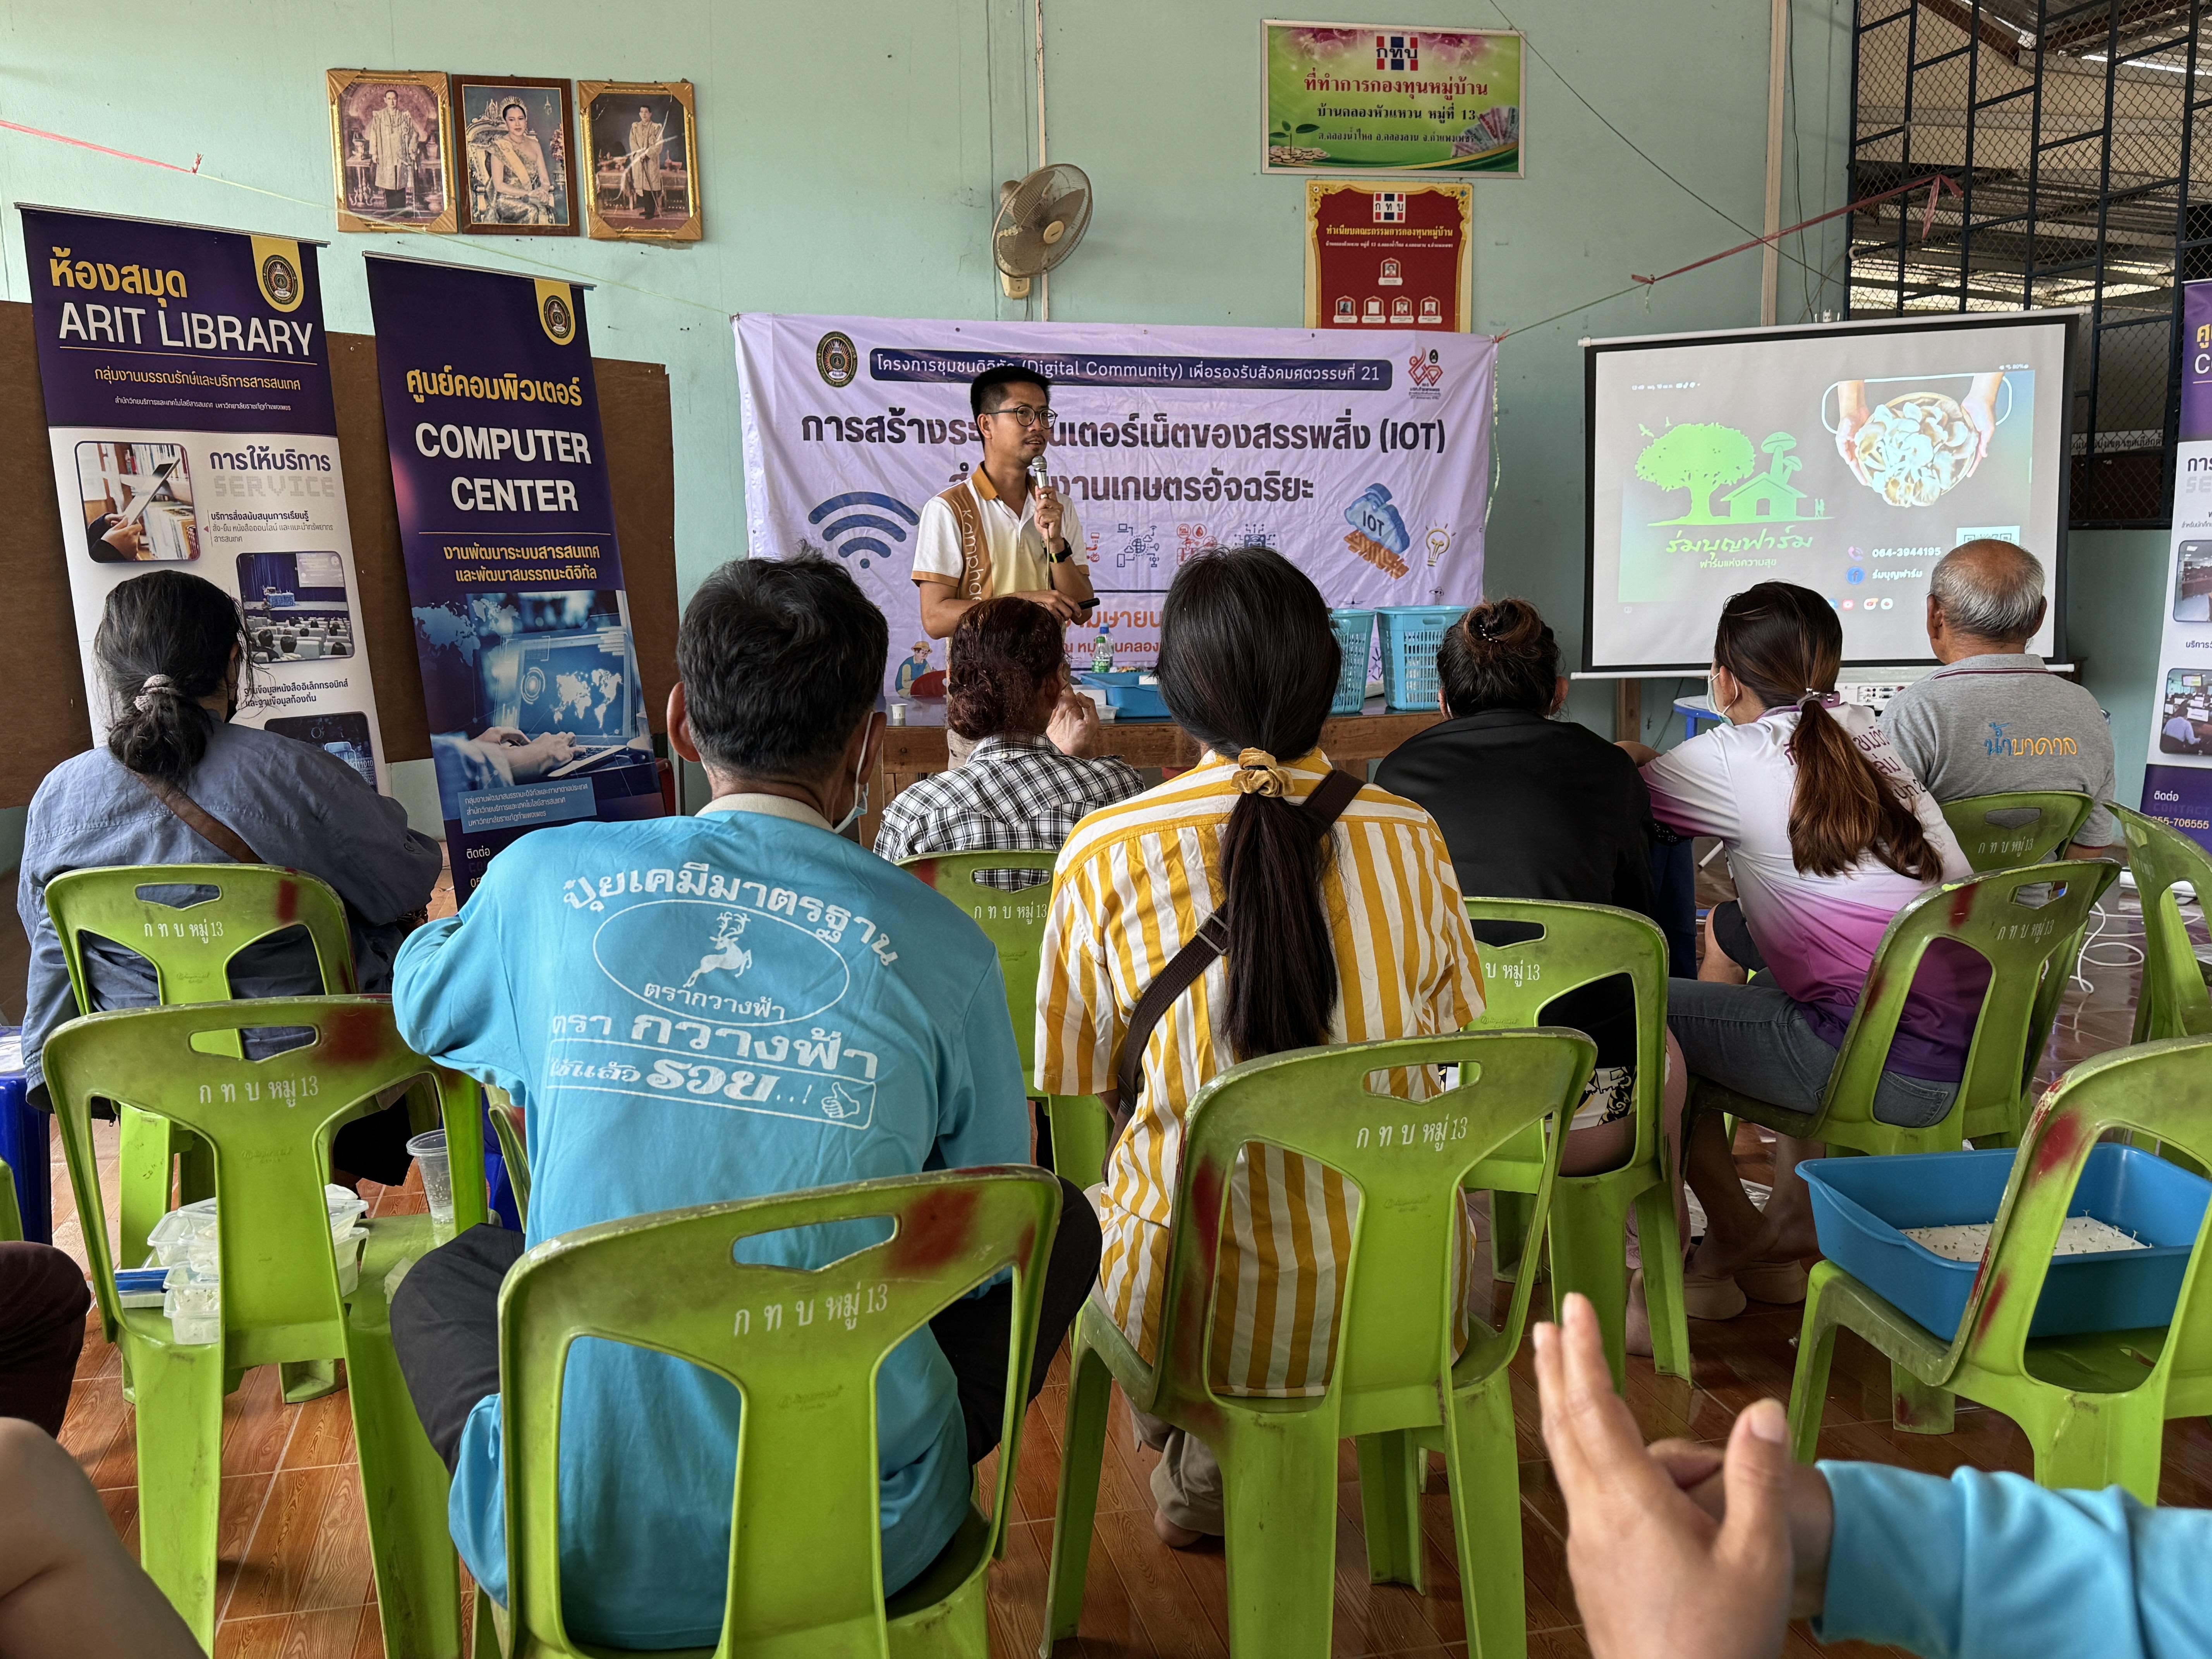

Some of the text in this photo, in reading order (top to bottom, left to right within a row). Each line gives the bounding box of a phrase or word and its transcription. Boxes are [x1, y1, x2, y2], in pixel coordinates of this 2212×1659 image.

[1304, 68, 1488, 100] ที่ทำการกองทุนหมู่บ้าน
[1317, 102, 1476, 124] บ้านคลองหัวแหวน หมู่ที่ 13
[50, 246, 187, 307] ห้องสมุด
[59, 302, 313, 356] ARIT LIBRARY
[94, 366, 301, 390] กลุ่มงานบรรณรักษ์และบริการสารสนเทศ
[406, 365, 582, 406] ศูนย์คอมพิวเตอร์
[1085, 362, 1183, 381] Community)
[1189, 363, 1355, 381] เพื่อรองรับสังคมศตวรรษที่
[1361, 366, 1379, 381] 21
[415, 422, 591, 464] COMPUTER
[1380, 418, 1445, 453] (IOT)
[210, 445, 331, 472] การให้บริการ
[214, 475, 335, 498] SERVICE
[451, 476, 579, 511] CENTER
[1362, 510, 1385, 537] IOT
[443, 542, 600, 560] งานพัฒนาระบบสารสนเทศ
[1666, 525, 1814, 560] ร่มบุญฟาร์ม
[455, 565, 597, 582] และพัฒนาสมรรถนะดิจิทัล
[1984, 722, 2077, 756] น้ำบาดาล
[2154, 790, 2179, 802] ติดต่อ
[466, 845, 490, 859] ติดต่อ
[563, 862, 898, 967] ปุ๋ยเคมีมาตรฐาน
[974, 905, 981, 919] ก
[988, 905, 996, 919] ท
[1002, 905, 1011, 919] บ
[1037, 904, 1047, 918] 13
[144, 923, 153, 937] ก
[158, 923, 168, 937] ท
[173, 923, 184, 937] บ
[212, 922, 223, 937] 13
[1486, 962, 1496, 978] บ
[1527, 964, 1540, 981] 13
[644, 982, 785, 1020] ตรากวางฟ้า
[551, 1013, 878, 1079] ตรา กวางฟ้า
[200, 1084, 211, 1104] ก
[221, 1083, 236, 1103] ท
[245, 1081, 259, 1101] บ
[302, 1075, 319, 1097] 13
[1357, 1127, 1369, 1149] ก
[1379, 1125, 1393, 1147] ท
[1401, 1124, 1415, 1145] บ
[1451, 1116, 1468, 1140] 13
[734, 1309, 750, 1336] ก
[764, 1304, 782, 1331] ท
[795, 1299, 814, 1327] บ
[866, 1283, 888, 1314] 13
